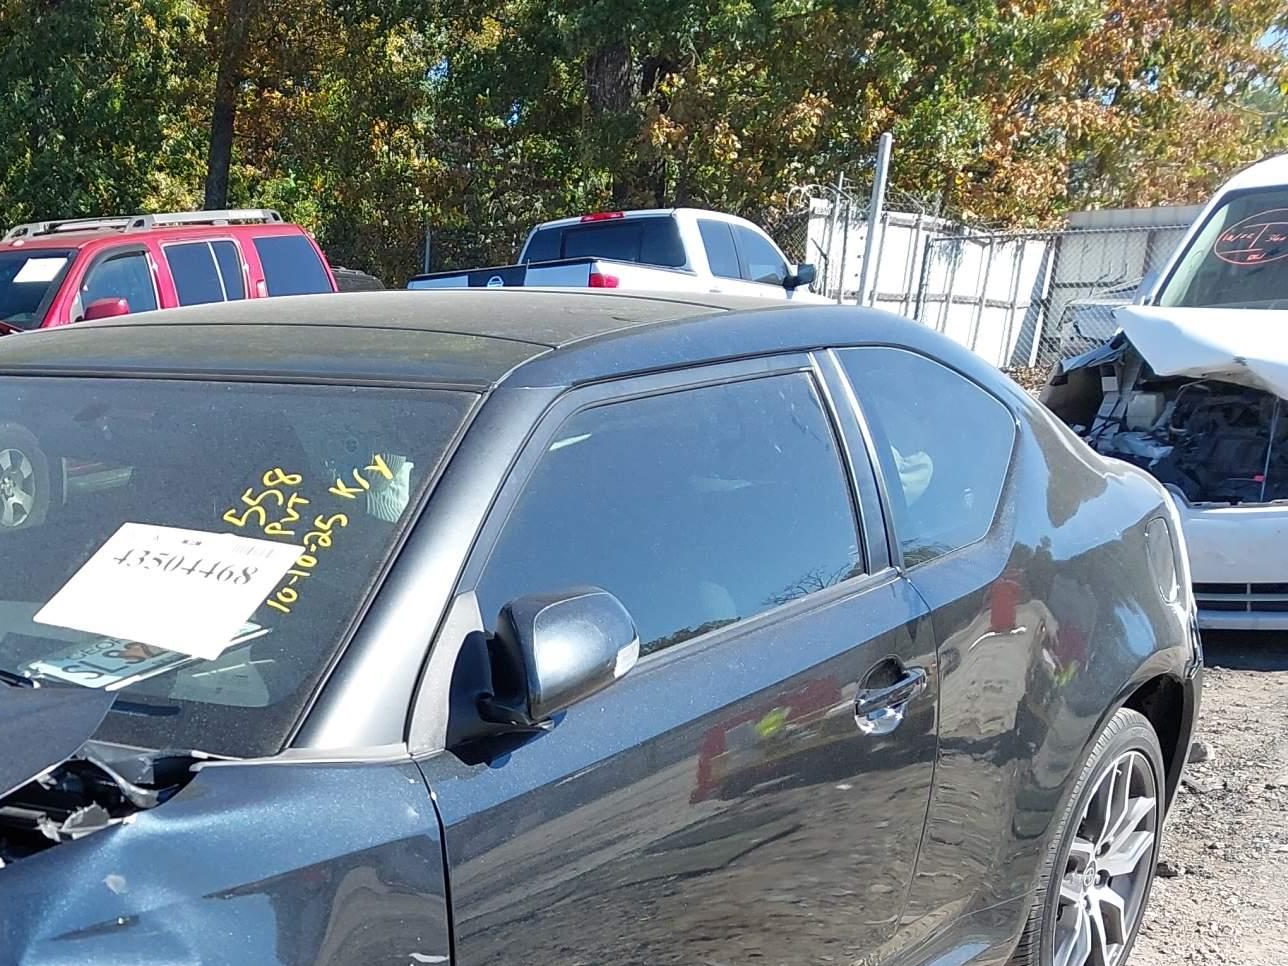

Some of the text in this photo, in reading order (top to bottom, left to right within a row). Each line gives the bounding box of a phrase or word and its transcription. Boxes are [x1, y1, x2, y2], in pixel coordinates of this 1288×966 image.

[223, 467, 302, 526] 558
[113, 548, 258, 585] 43504468
[266, 513, 348, 613] 10-10-25
